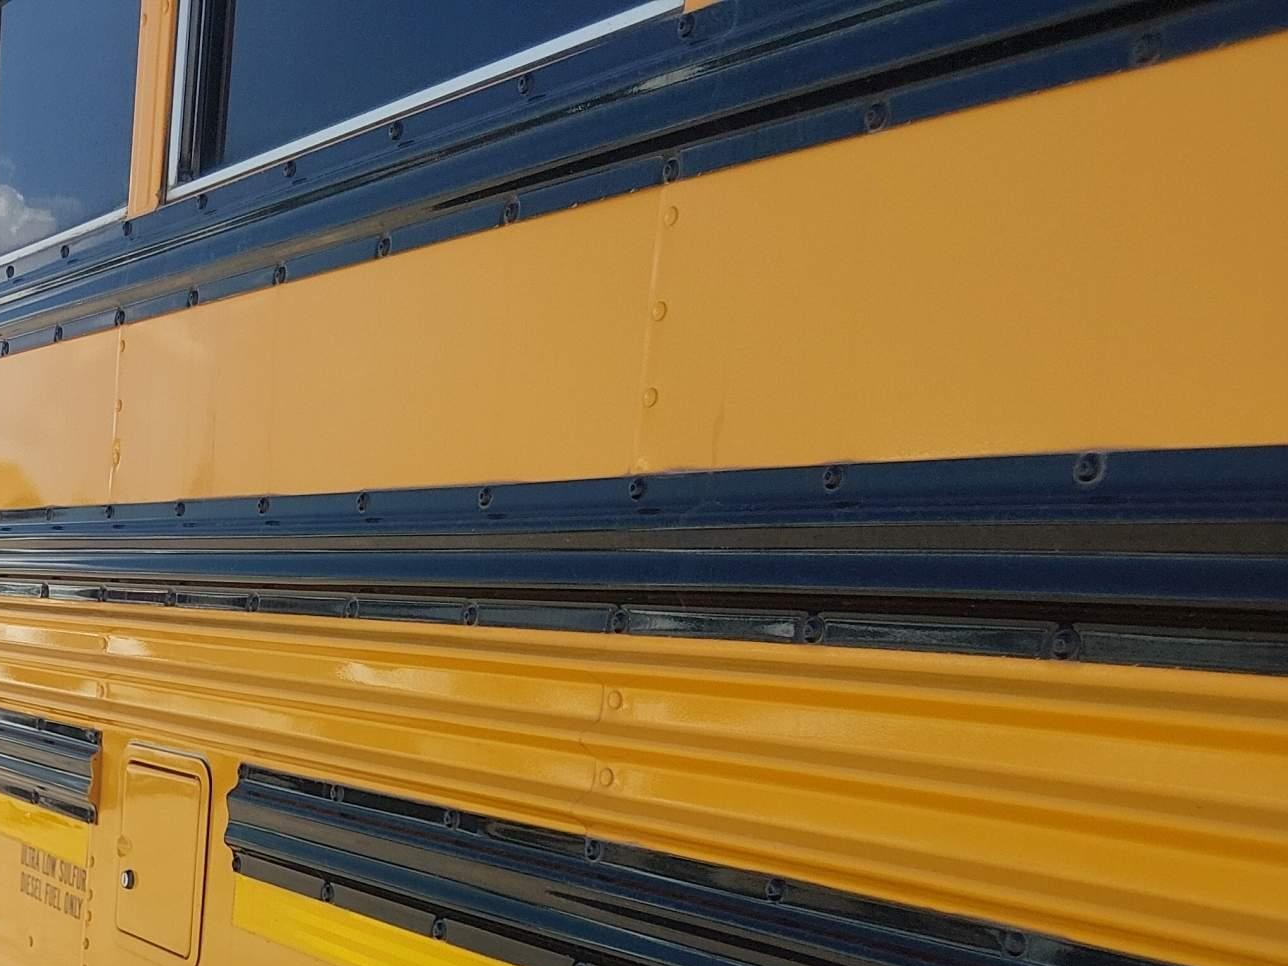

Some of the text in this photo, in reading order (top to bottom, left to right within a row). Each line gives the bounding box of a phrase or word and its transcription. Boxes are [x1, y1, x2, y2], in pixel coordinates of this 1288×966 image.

[21, 845, 87, 892] ULTRA LOW SULFUR
[20, 871, 84, 920] DIESEL FUEL ONLY
